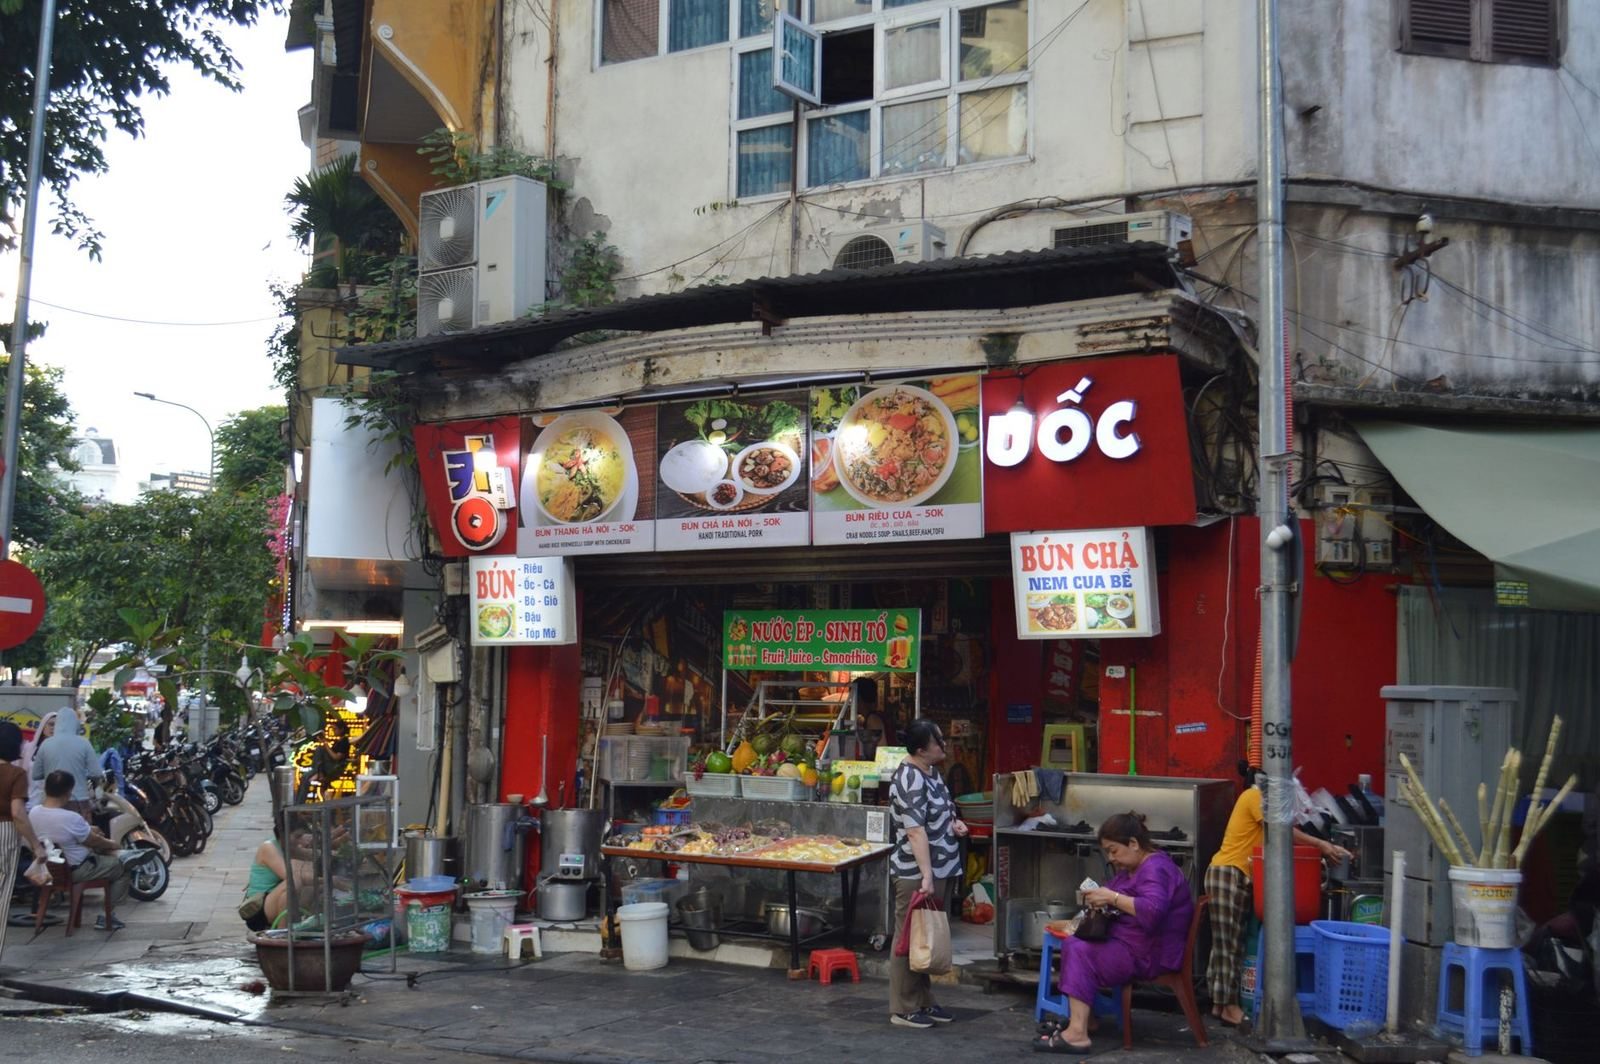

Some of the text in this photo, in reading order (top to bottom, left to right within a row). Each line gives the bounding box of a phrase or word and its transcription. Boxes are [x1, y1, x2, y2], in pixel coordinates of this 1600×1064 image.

[892, 510, 912, 519] CUA
[925, 508, 944, 518] 50K
[763, 517, 781, 527] 50K
[554, 526, 580, 536] THANG
[619, 524, 636, 533] 50K
[698, 529, 763, 540] HANOI TRADITIONAL PORK
[845, 532, 858, 540] CRAB
[858, 530, 877, 539] NOODLE
[1019, 531, 1139, 572] BÚN CHẢ
[476, 560, 516, 600] BÚN
[1028, 576, 1068, 591] NEM
[1073, 575, 1106, 590] CUA
[751, 615, 793, 643] NƯỚC
[795, 615, 815, 643] ÉP
[824, 622, 864, 643] SINH
[865, 612, 888, 642] TỐ
[761, 648, 785, 665] Fruit
[786, 649, 812, 665] Juice
[822, 648, 878, 666] Smoothies
